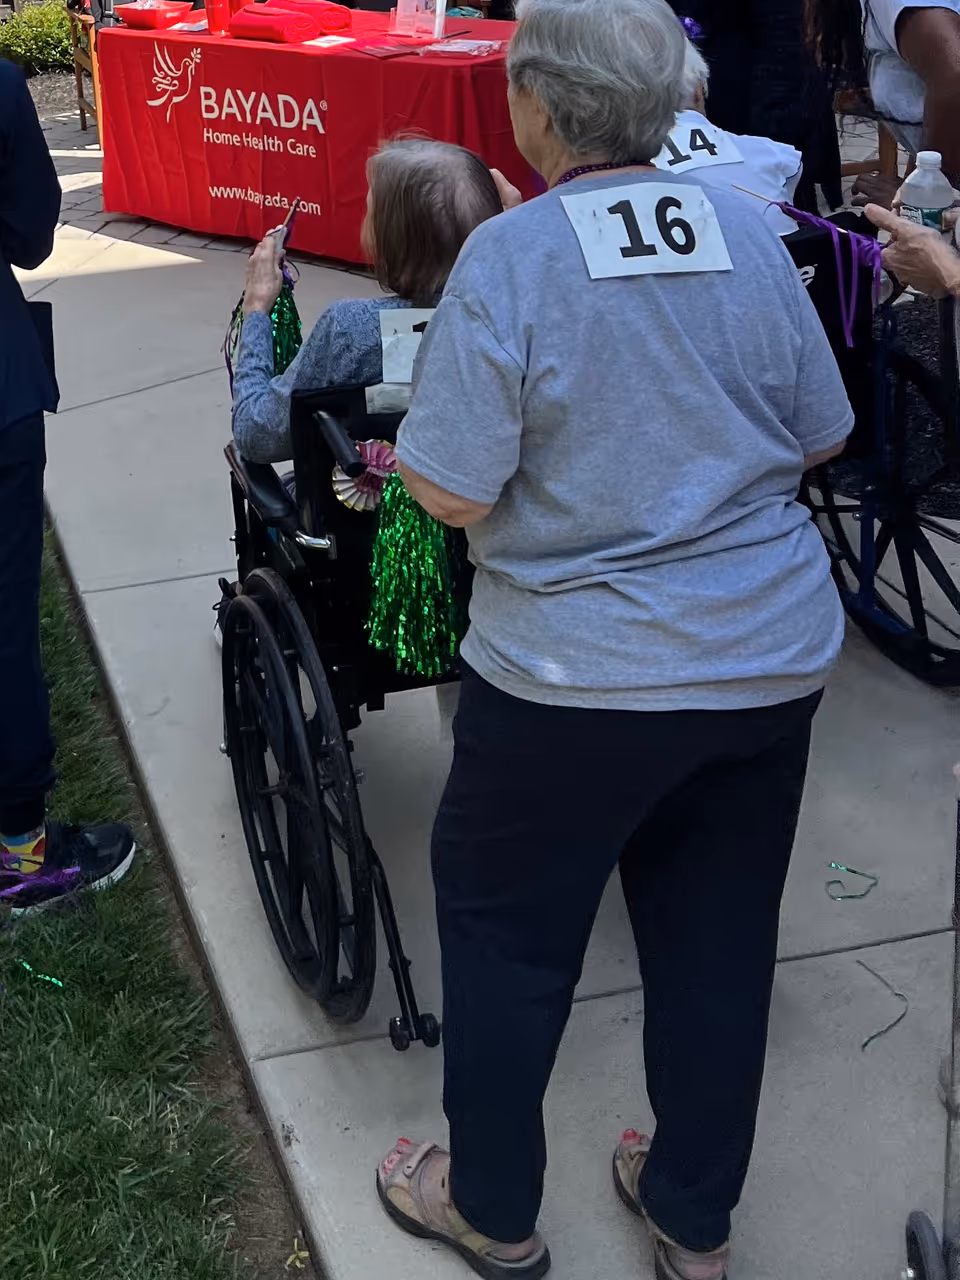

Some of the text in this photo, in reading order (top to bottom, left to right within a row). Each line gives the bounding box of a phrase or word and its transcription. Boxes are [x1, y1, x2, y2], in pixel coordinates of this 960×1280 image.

[203, 128, 317, 158] Home Health Care
[667, 128, 718, 167] 14
[606, 196, 696, 258] 16
